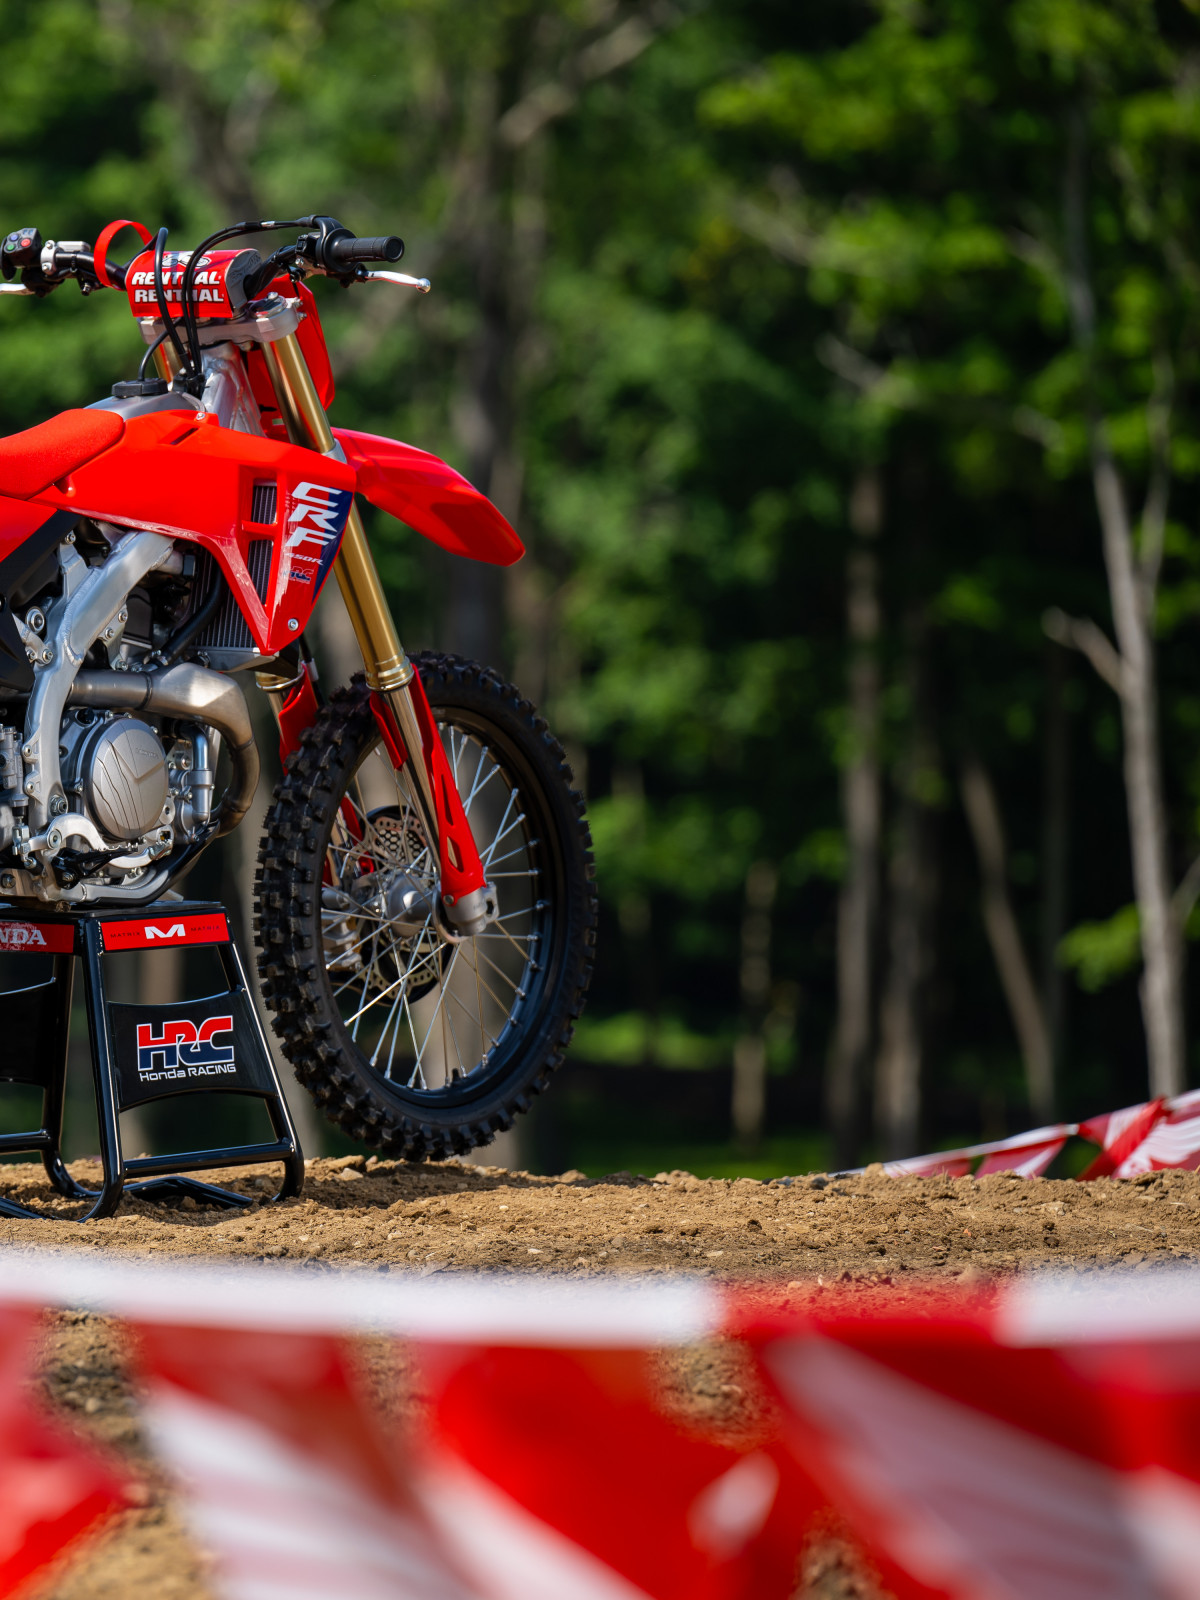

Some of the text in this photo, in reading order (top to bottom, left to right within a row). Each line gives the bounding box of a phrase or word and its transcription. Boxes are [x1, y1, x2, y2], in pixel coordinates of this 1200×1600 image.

[285, 481, 343, 547] CRF
[136, 1014, 235, 1072] HRC
[139, 1062, 237, 1082] Honda RACING
